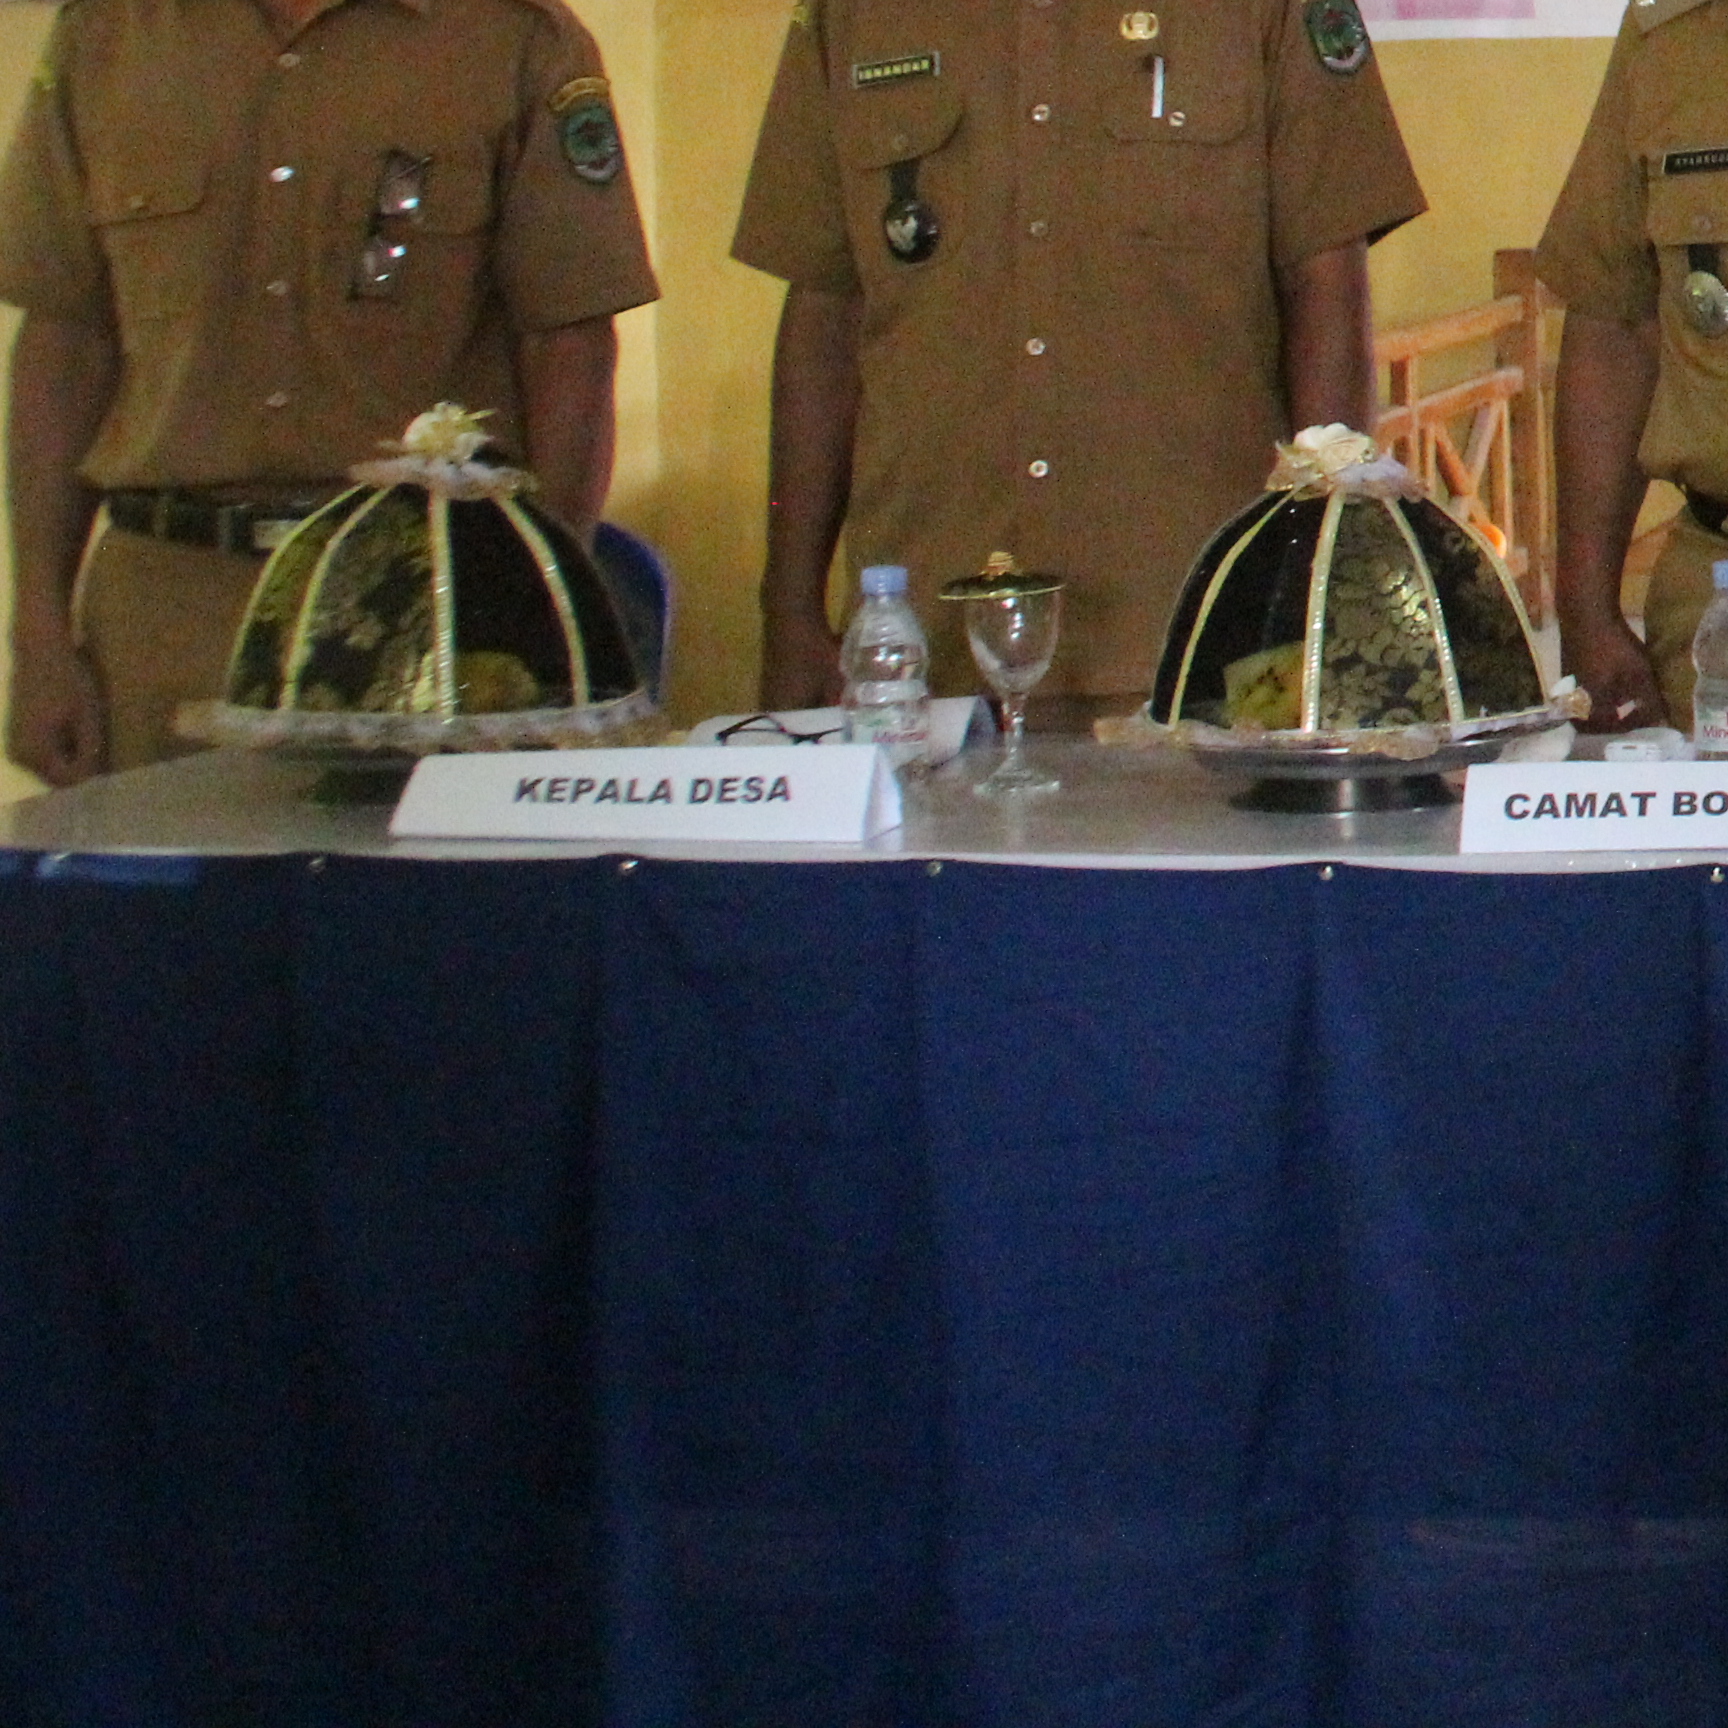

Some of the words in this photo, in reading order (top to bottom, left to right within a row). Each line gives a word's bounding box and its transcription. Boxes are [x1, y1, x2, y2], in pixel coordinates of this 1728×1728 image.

[514, 777, 673, 804] KEPALA
[689, 774, 792, 804] DESA
[1503, 790, 1657, 821] CAMAT
